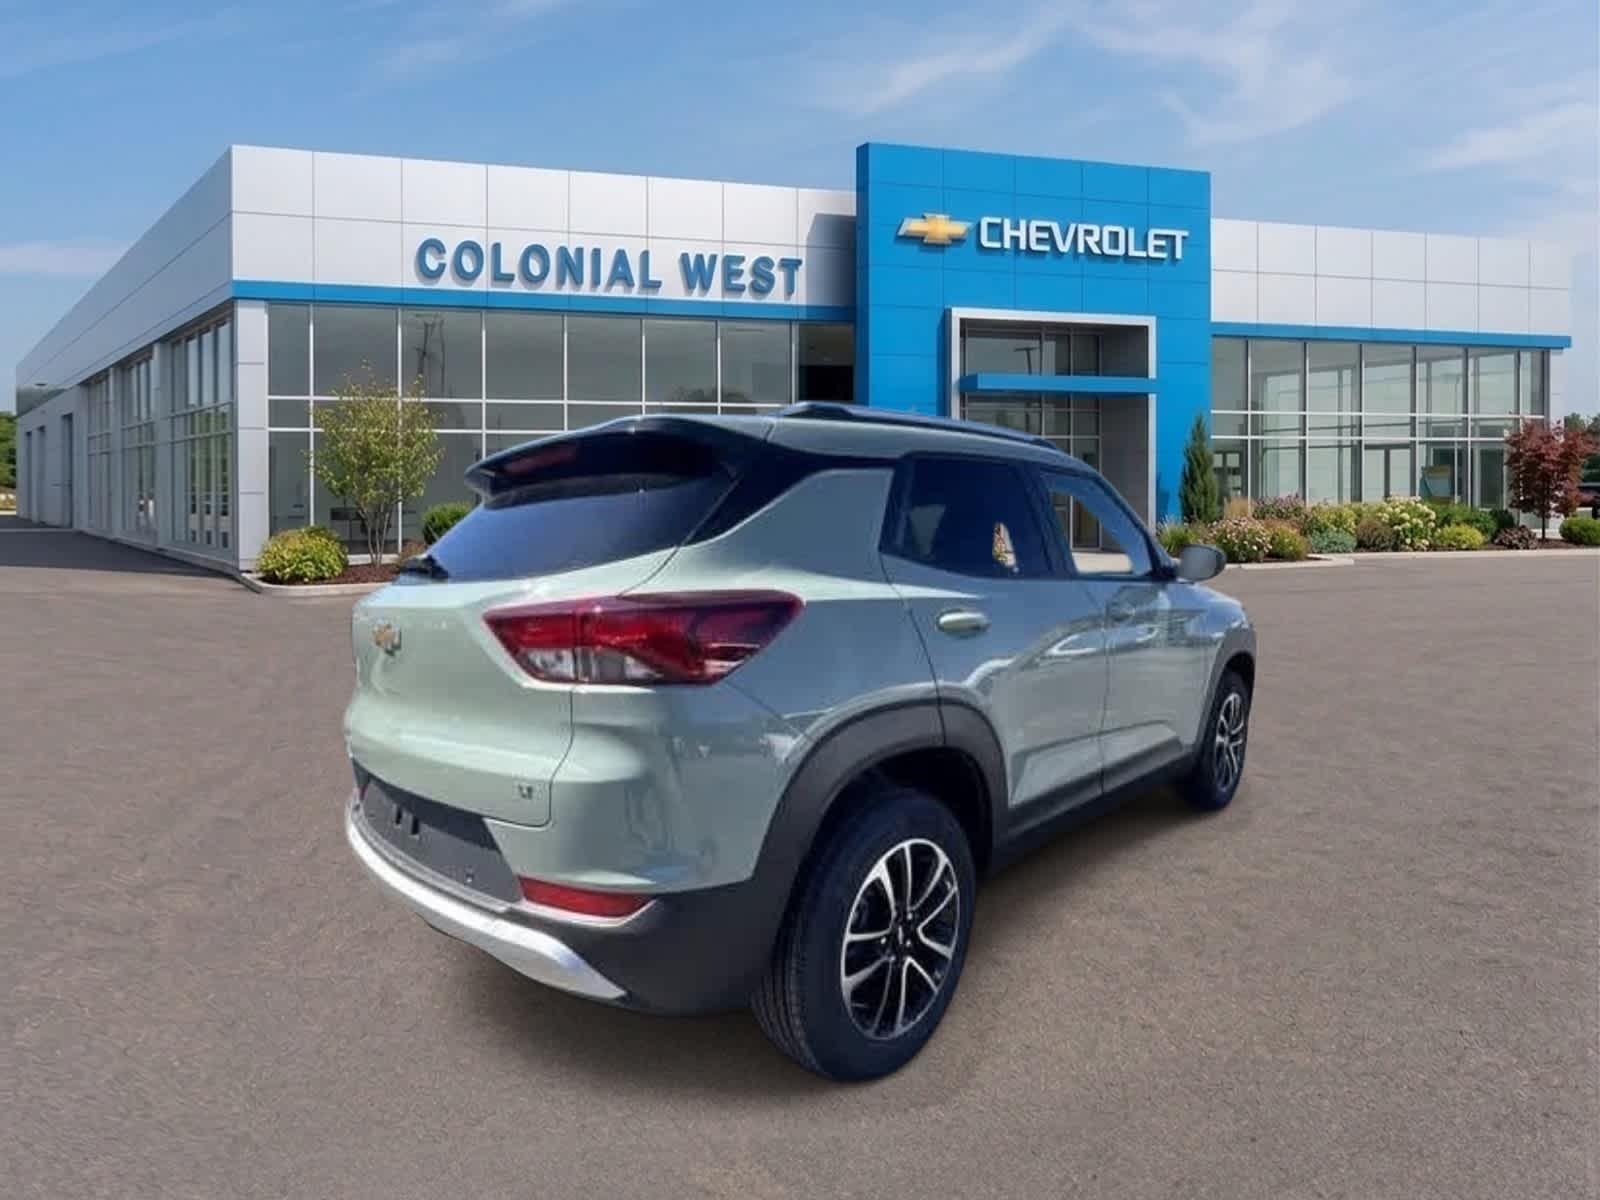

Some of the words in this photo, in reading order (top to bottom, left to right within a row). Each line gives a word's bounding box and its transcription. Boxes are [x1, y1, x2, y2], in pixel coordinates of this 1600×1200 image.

[980, 216, 1189, 260] CHEVROLET
[416, 238, 662, 289] COLONIAL
[680, 252, 803, 296] WEST
